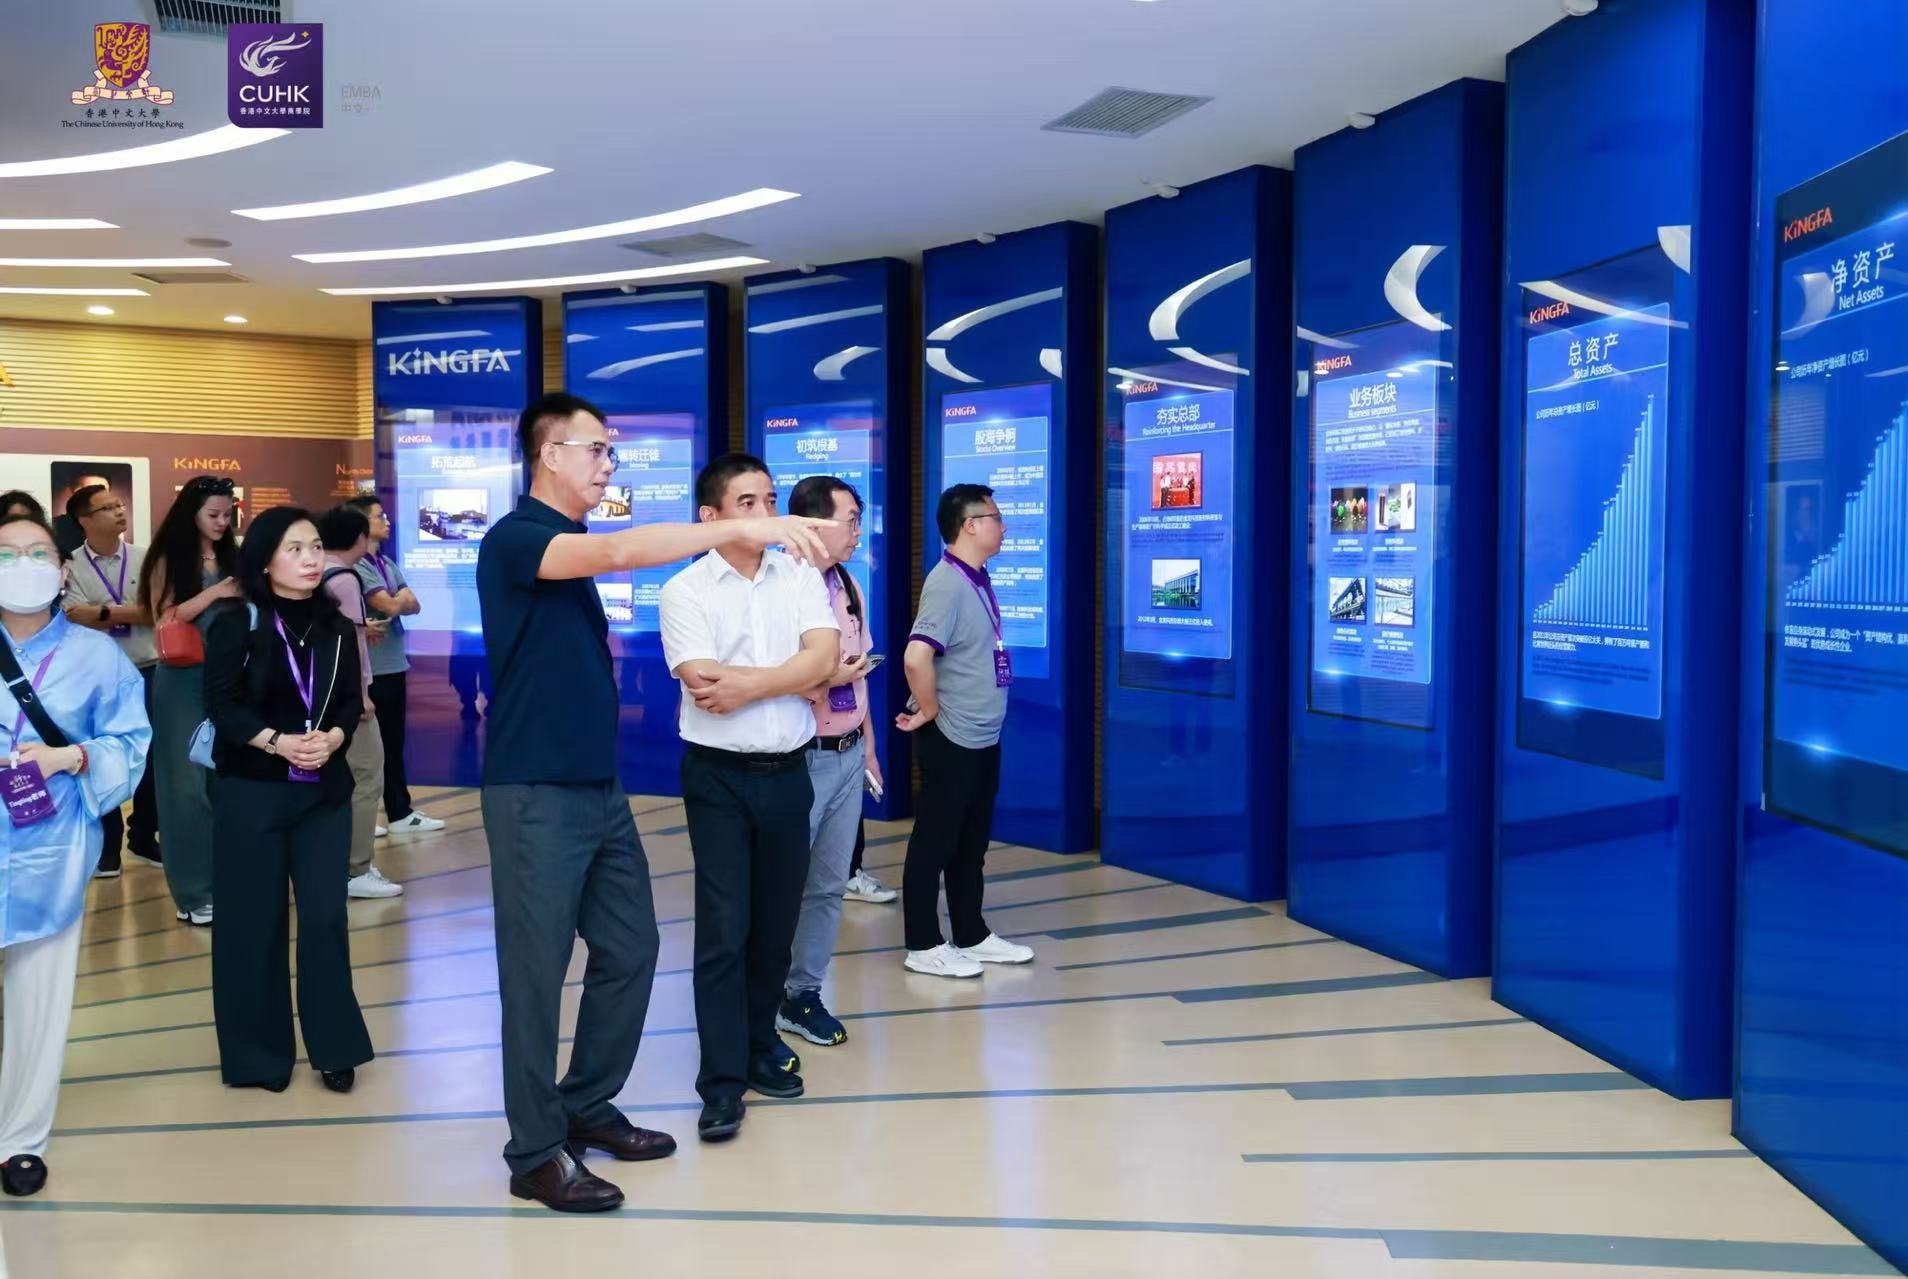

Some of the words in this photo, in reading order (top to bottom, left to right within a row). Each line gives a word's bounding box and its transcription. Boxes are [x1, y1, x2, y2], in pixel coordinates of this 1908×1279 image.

[1831, 241, 1895, 294] 净资产
[1839, 293, 1855, 311] Net
[1856, 285, 1885, 304] Assets
[1568, 332, 1619, 366] 总资产
[1573, 366, 1589, 380] Total
[1590, 363, 1613, 377] Assets
[1349, 382, 1397, 408] 业务板块
[1157, 403, 1201, 425] 夯实总部
[1172, 424, 1181, 433] the
